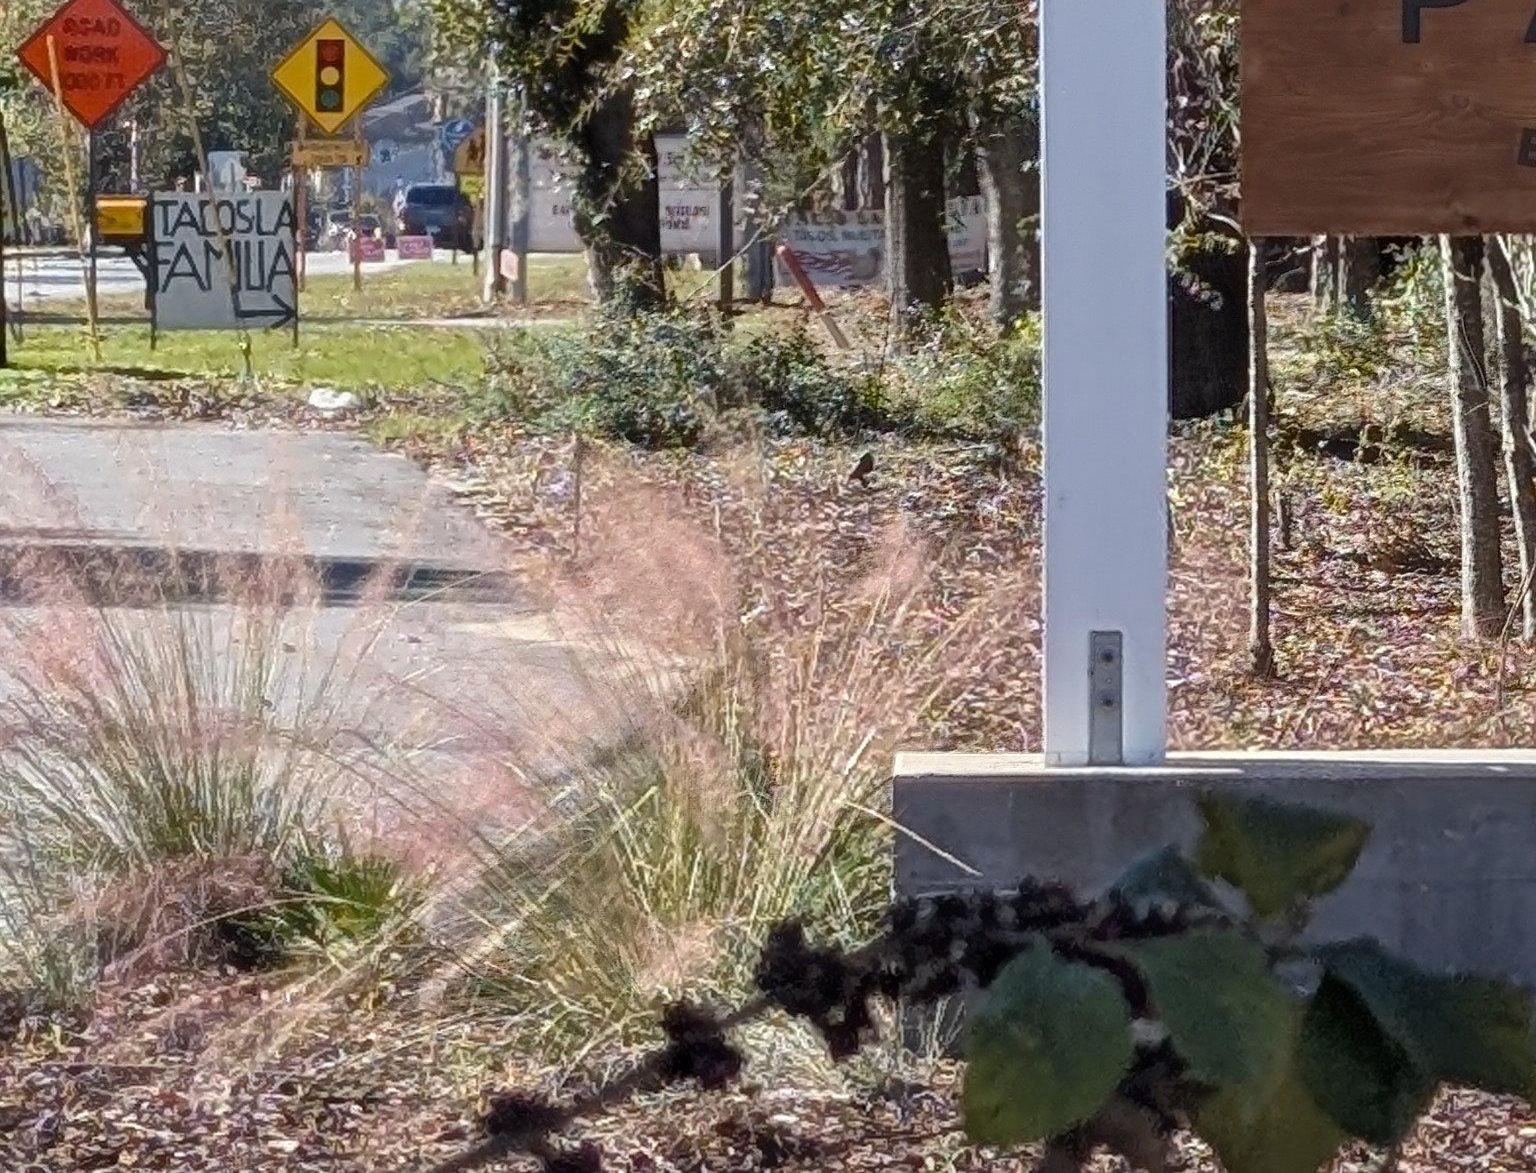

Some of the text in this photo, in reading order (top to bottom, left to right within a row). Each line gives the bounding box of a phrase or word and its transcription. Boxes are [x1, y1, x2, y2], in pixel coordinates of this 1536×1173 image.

[154, 198, 297, 241] TACOS LA
[153, 238, 298, 293] FAMILIA
